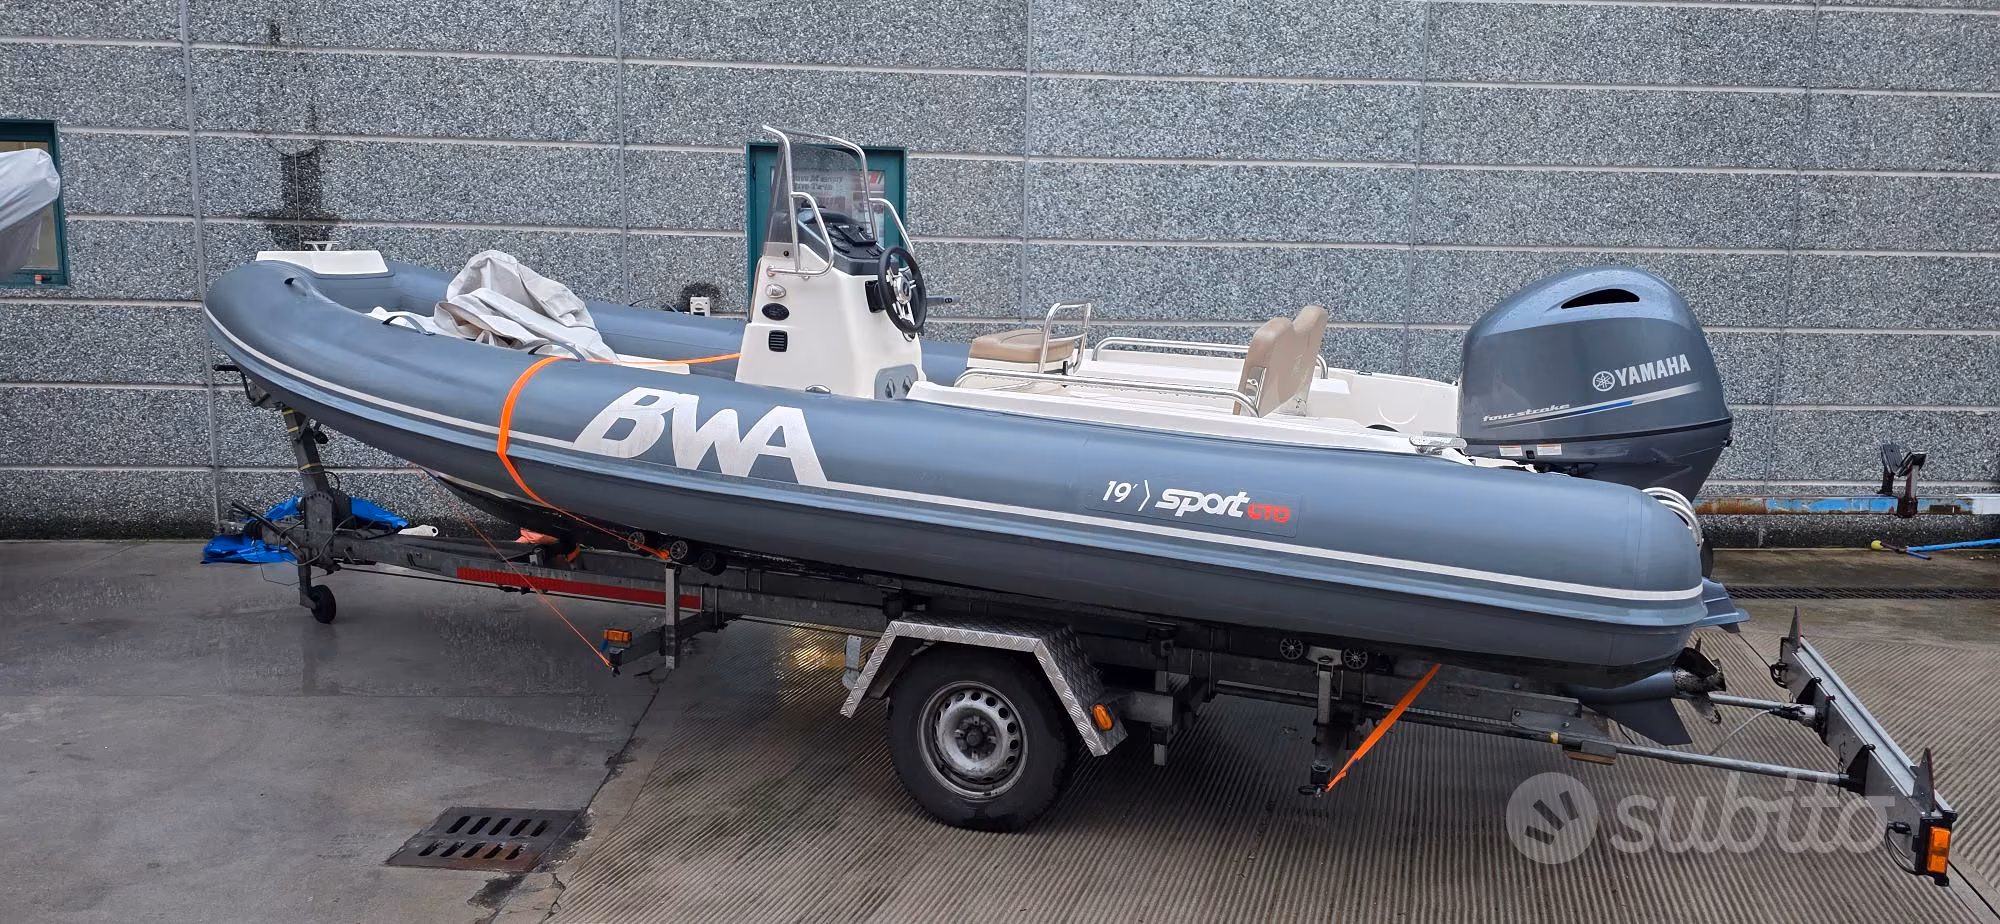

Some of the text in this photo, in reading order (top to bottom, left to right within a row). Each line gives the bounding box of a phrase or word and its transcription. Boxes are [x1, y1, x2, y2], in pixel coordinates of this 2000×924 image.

[1614, 353, 1692, 387] YAMAHA
[1483, 404, 1570, 422] four stroke
[573, 386, 829, 486] BWA
